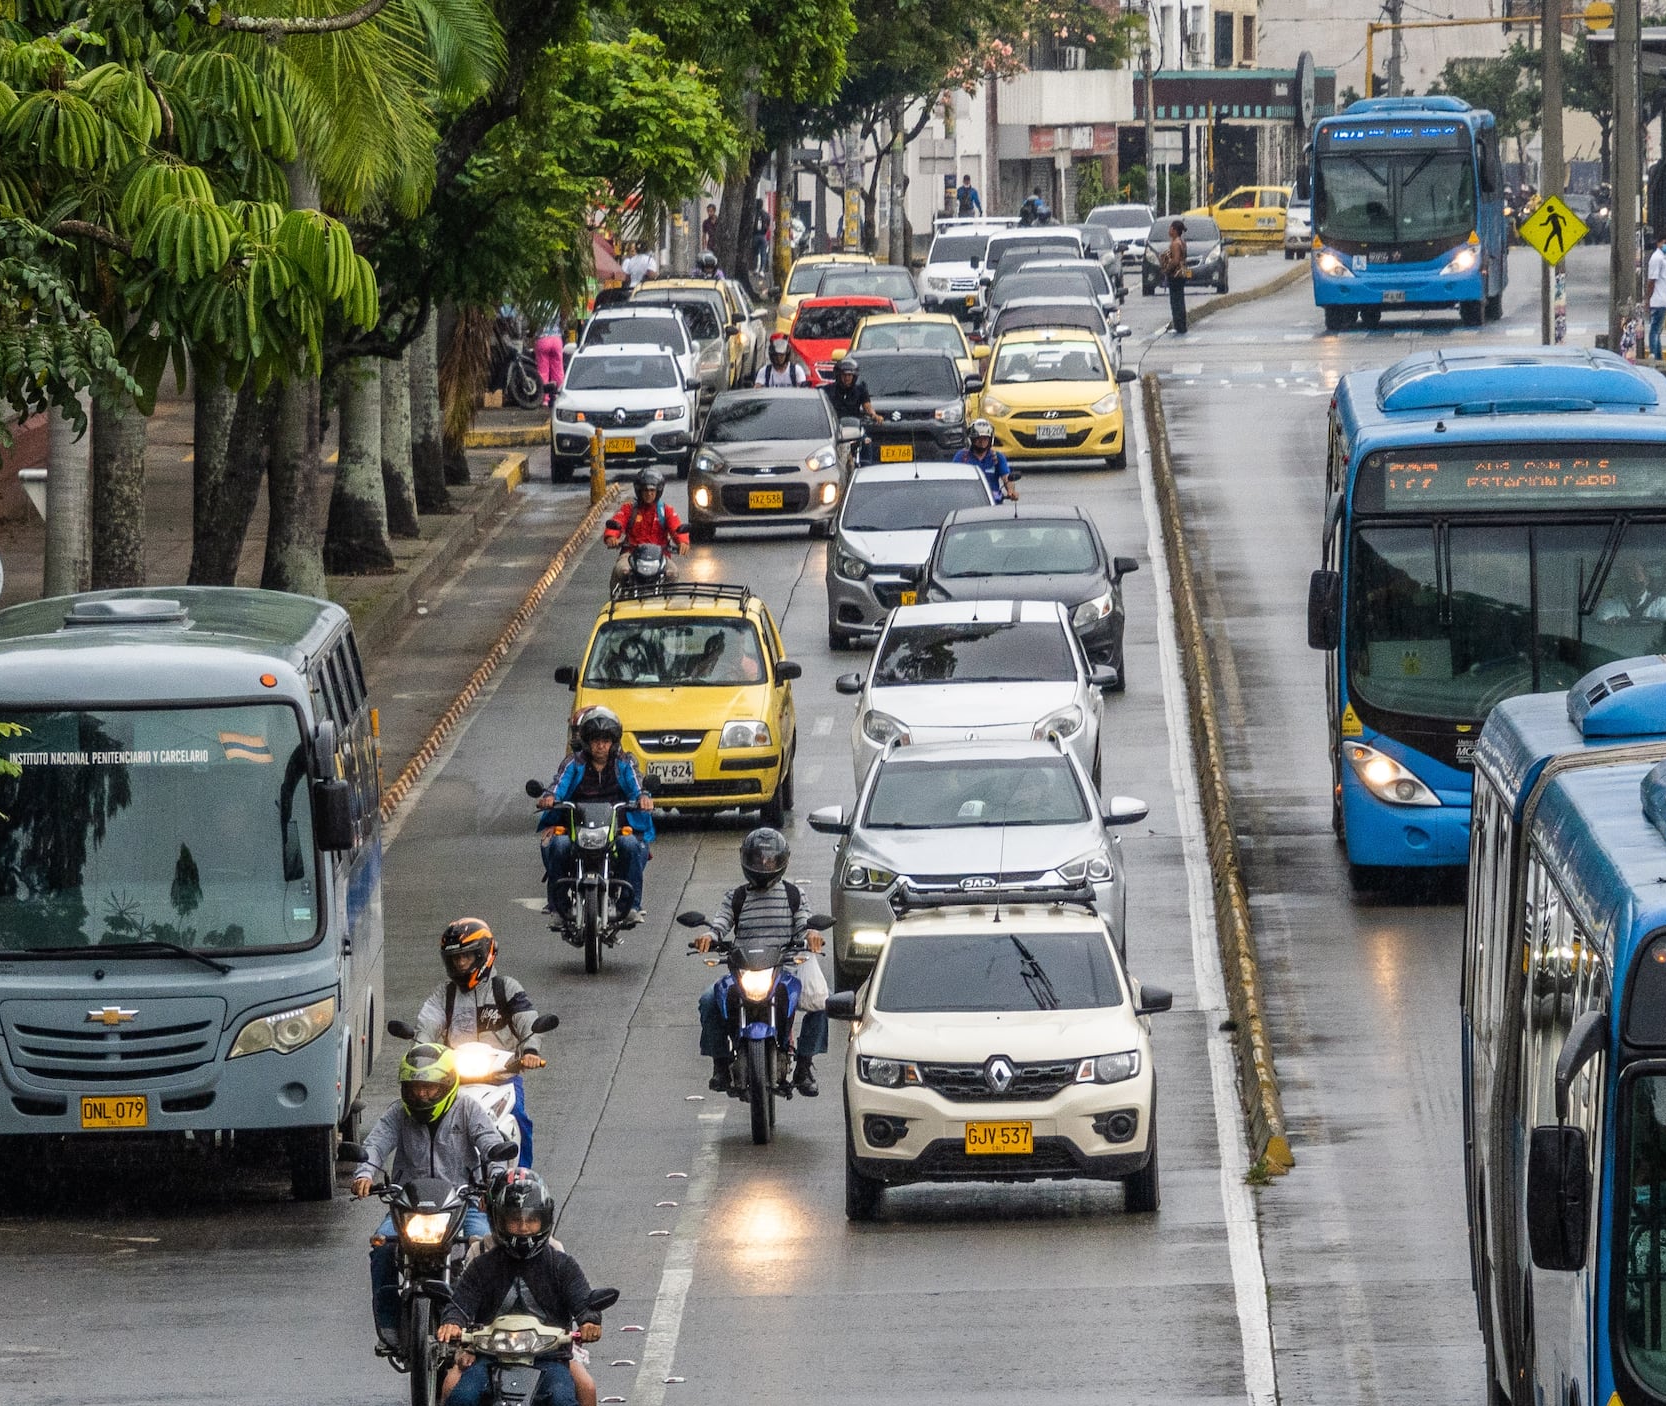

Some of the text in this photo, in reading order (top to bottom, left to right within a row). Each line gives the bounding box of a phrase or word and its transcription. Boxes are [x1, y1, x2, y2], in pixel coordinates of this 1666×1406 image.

[9, 750, 208, 765] INSTITUTO NACIONAL PENITENCIARIO Y CARCELARIO
[966, 879, 992, 888] JAC
